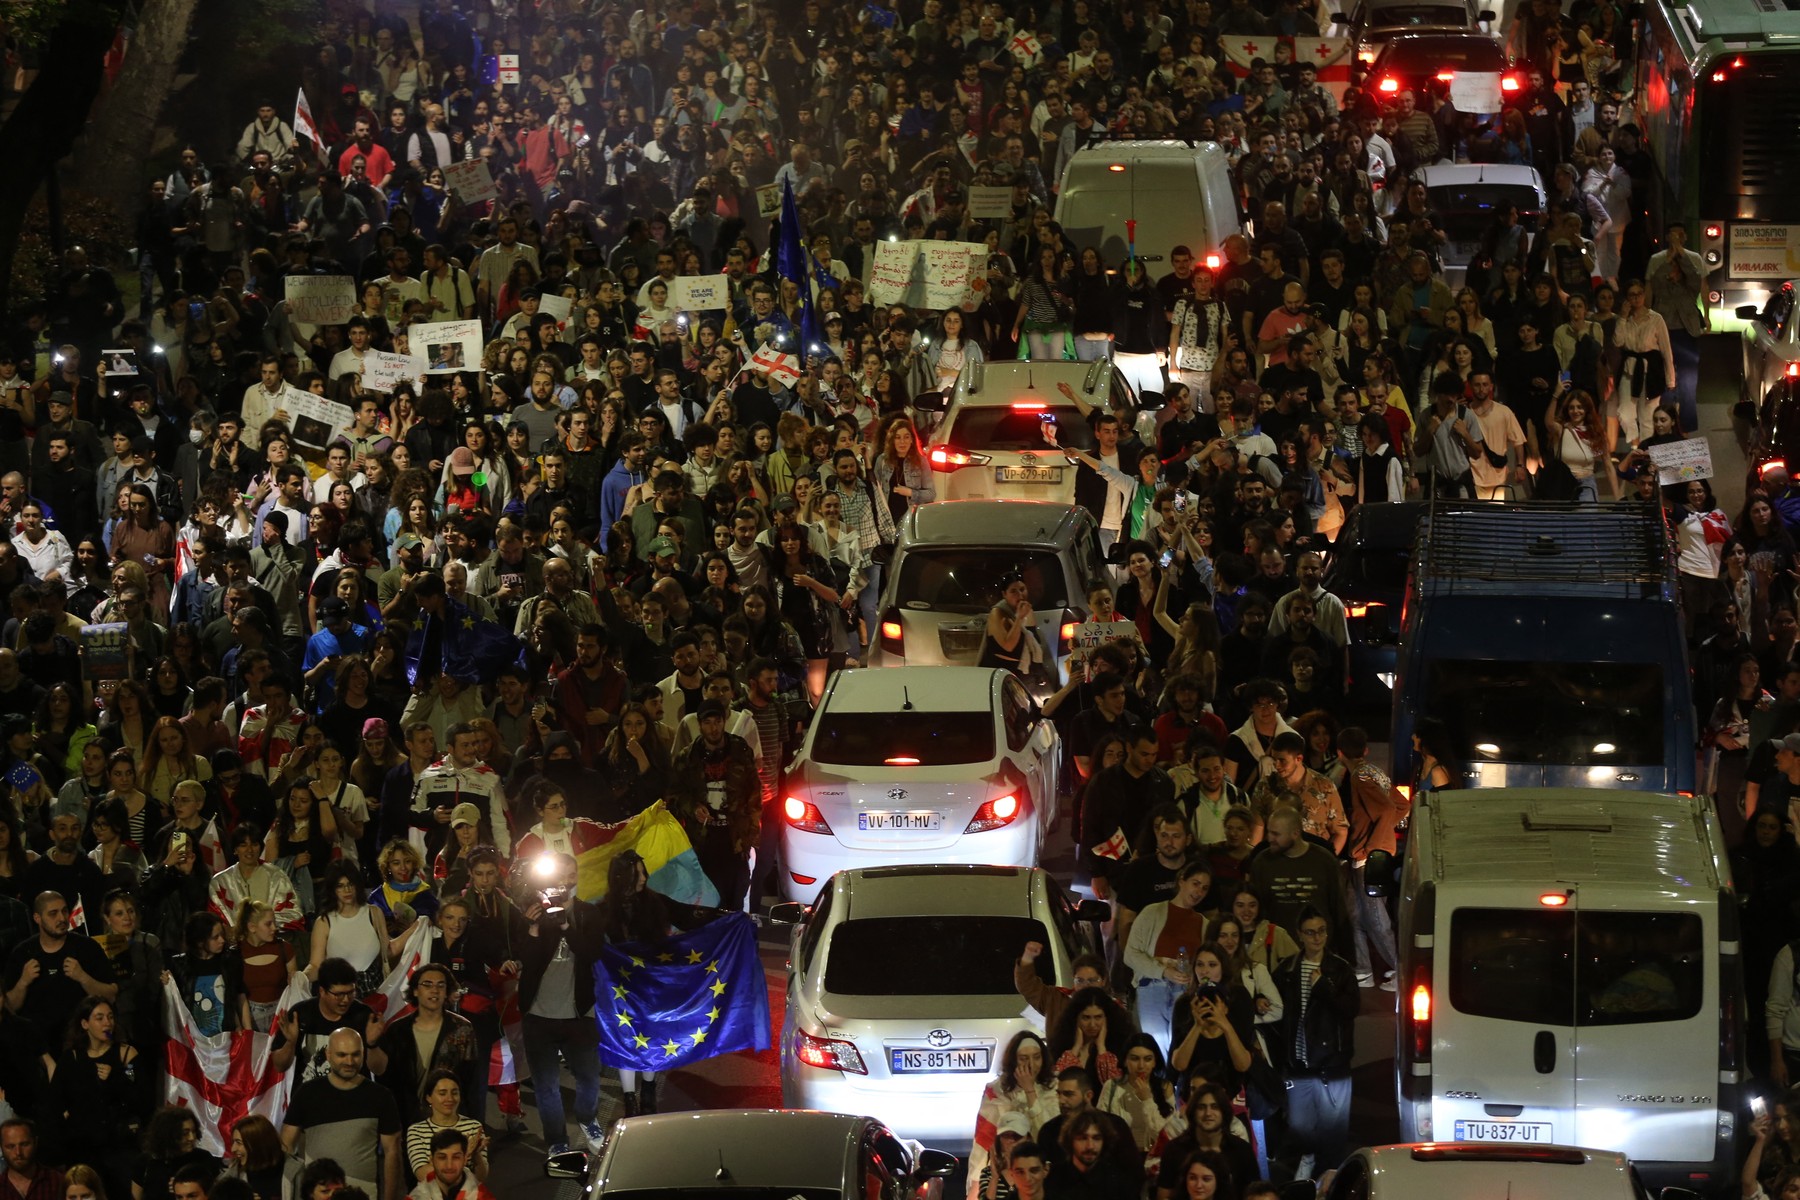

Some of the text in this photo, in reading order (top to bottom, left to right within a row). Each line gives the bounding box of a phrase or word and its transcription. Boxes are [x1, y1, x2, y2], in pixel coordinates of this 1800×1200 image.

[1734, 263, 1780, 271] WALMARK
[1004, 469, 1054, 480] VP-679-PV
[868, 815, 930, 828] VV-101-MV
[904, 1053, 976, 1068] NS-851-NN
[1446, 1090, 1482, 1100] OPEL
[1617, 1094, 1665, 1103] VIVARO
[1467, 1124, 1540, 1140] TU-837-UT
